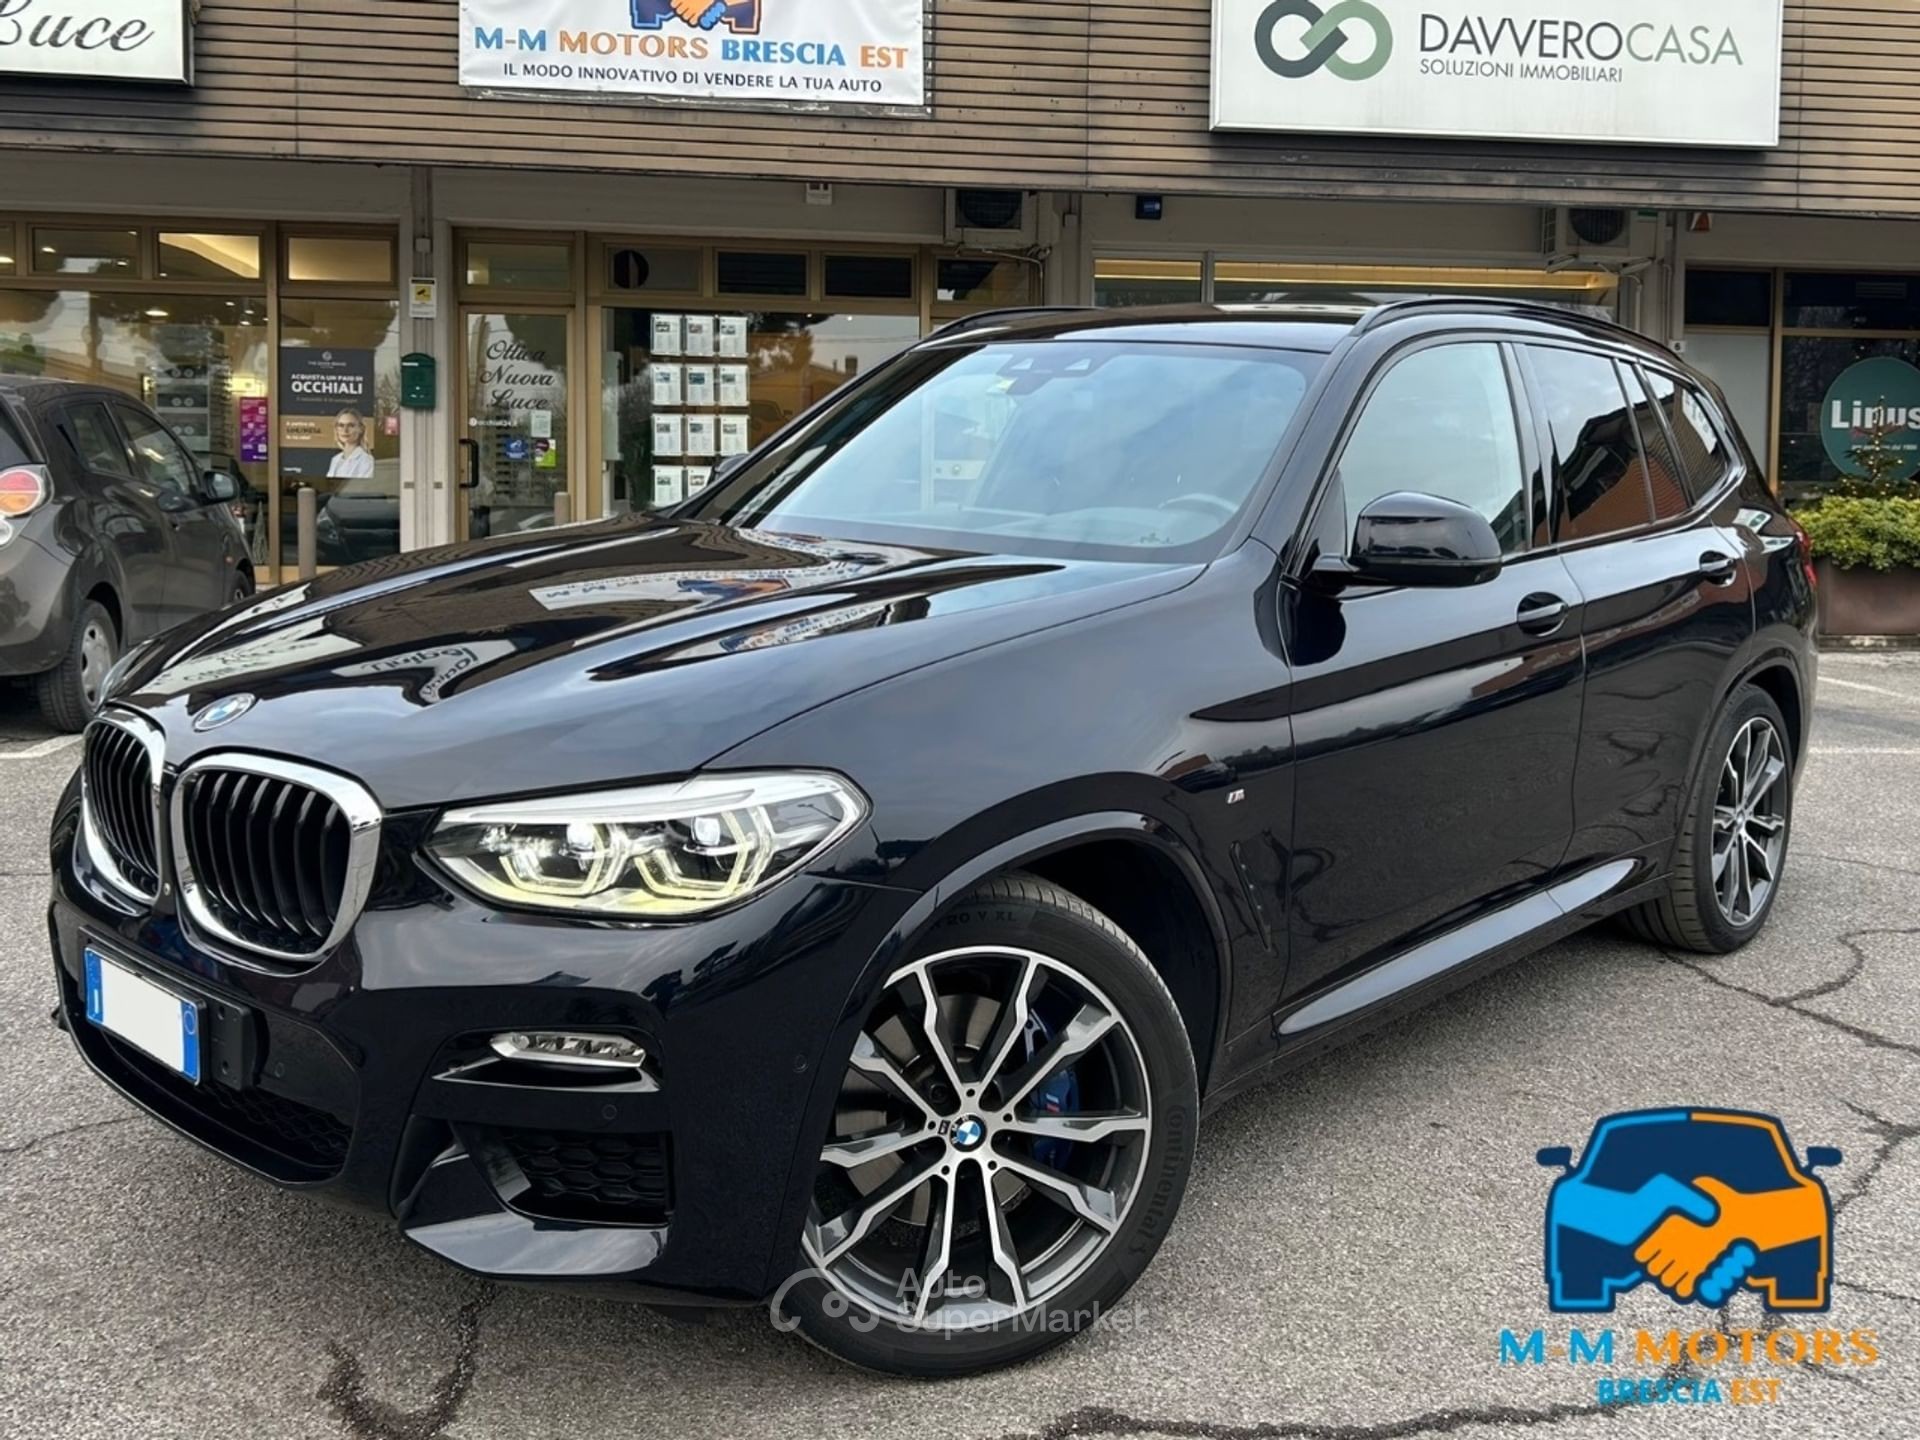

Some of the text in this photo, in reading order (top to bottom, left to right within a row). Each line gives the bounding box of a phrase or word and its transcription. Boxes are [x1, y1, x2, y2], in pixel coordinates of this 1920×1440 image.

[475, 27, 907, 68] M-M MOTORS BRESCIA EST
[504, 63, 882, 92] IL MODO INNOVATIVO DI VENDERE LA TUA AUTO
[1420, 59, 1622, 83] SOLUZIONI IMMOBILIARI
[487, 340, 545, 361] Ottica
[480, 364, 555, 385] Nuova
[291, 381, 363, 394] OCCHIALI
[486, 389, 548, 409] Luce
[1831, 400, 1920, 429] Linus
